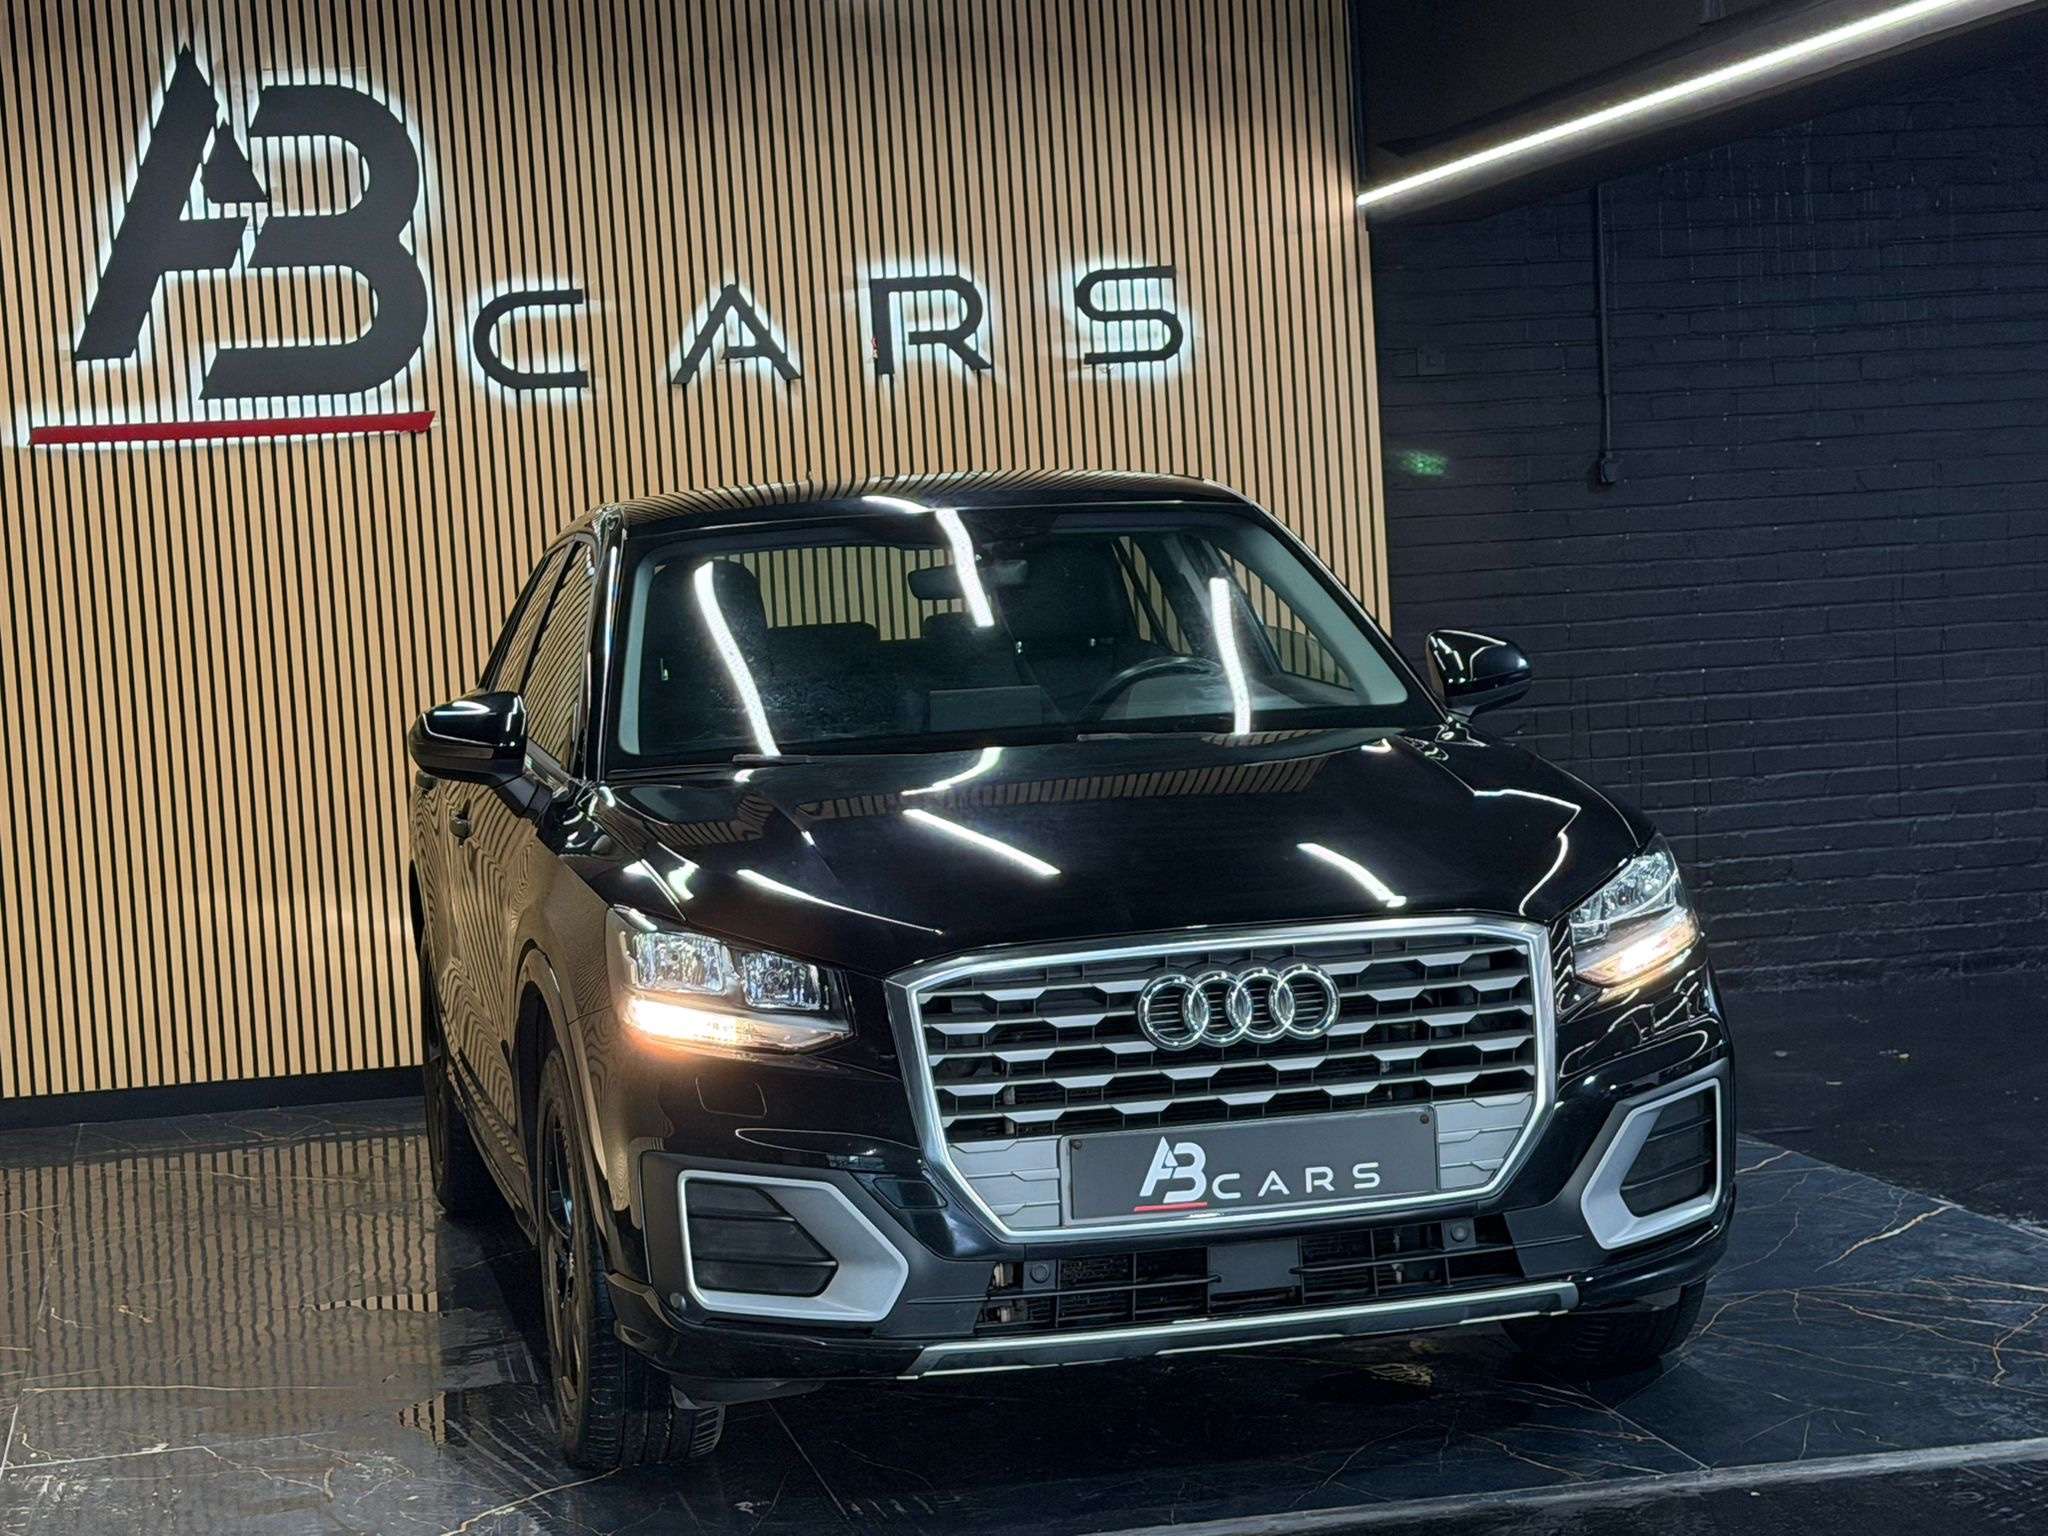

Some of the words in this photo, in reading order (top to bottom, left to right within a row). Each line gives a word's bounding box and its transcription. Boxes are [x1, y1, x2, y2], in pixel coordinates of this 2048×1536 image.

[74, 43, 428, 399] AB
[472, 265, 1184, 388] CARS
[1139, 1136, 1206, 1204] AB
[1212, 1162, 1381, 1200] CARS
